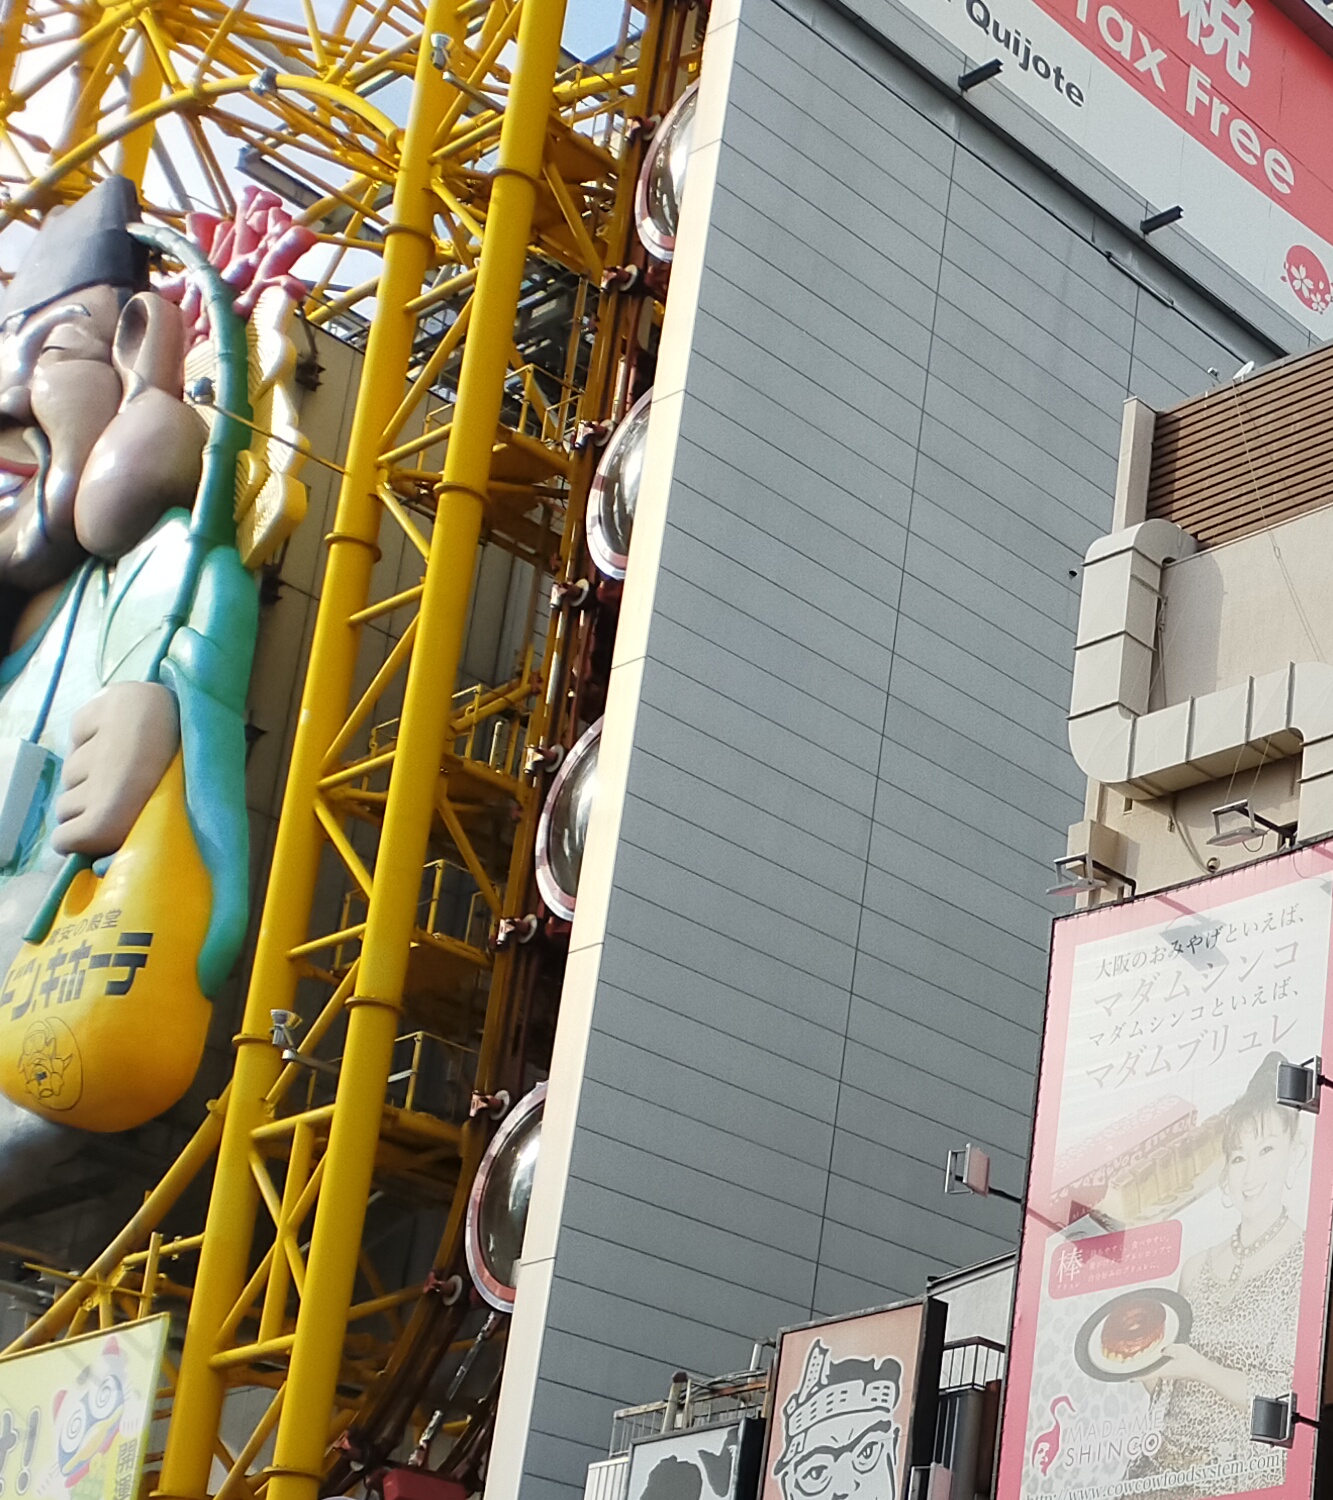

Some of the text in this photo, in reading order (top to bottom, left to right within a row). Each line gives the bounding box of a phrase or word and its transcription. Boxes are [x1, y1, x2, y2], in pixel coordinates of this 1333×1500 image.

[965, 0, 1086, 108] Quijote
[1185, 63, 1296, 194] Free
[1093, 941, 1300, 1017] マダムシンコ
[1094, 903, 1304, 981] 大阪のおみやげといえば、
[1089, 976, 1299, 1047] マダムシンコといえば、
[1085, 1014, 1298, 1089] マダムブリュレ
[1055, 1246, 1083, 1283] 棒
[1064, 1432, 1161, 1467] SHINCO
[1066, 1407, 1167, 1442] MADAME
